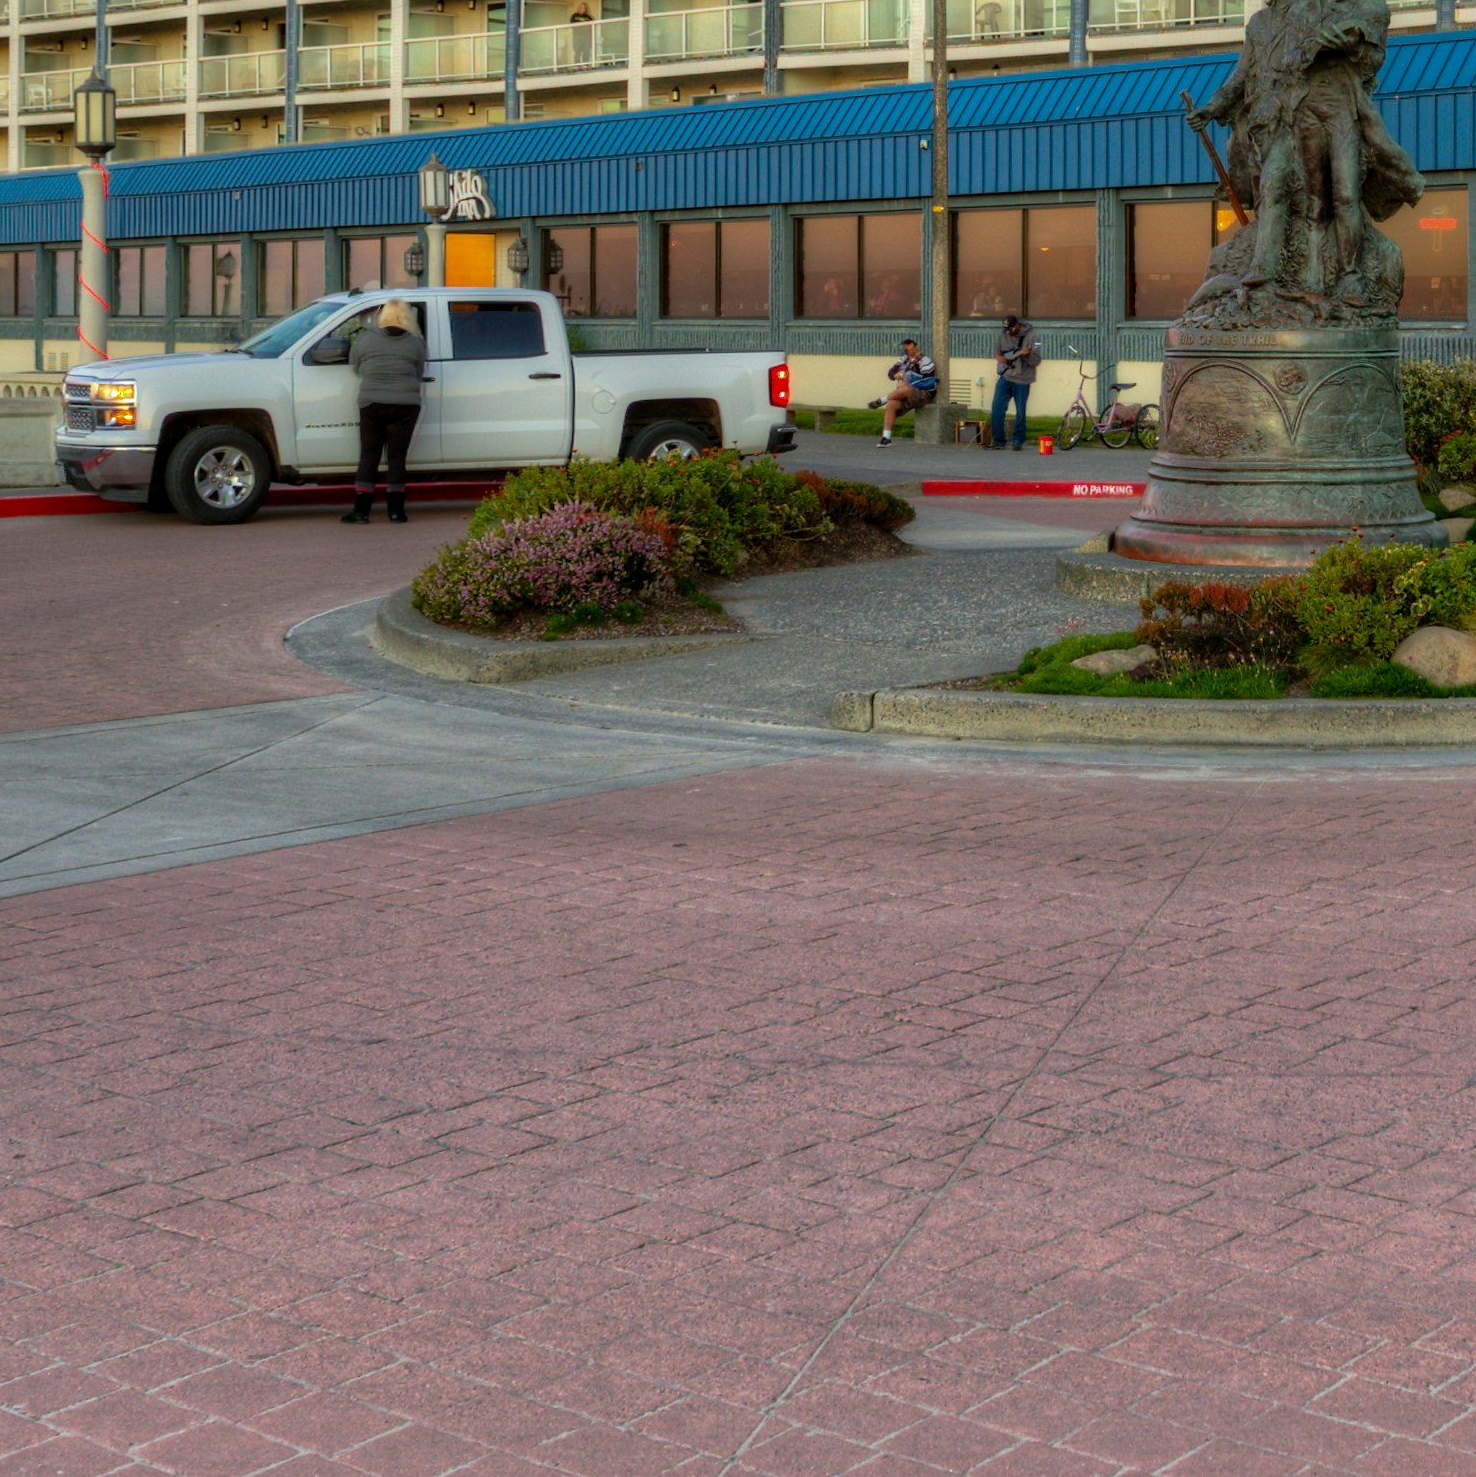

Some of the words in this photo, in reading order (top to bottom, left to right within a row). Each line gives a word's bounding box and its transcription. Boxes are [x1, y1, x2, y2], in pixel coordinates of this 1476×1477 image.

[1242, 334, 1278, 346] TRAIL
[1073, 484, 1088, 496] NO
[1089, 485, 1134, 496] PARKING
